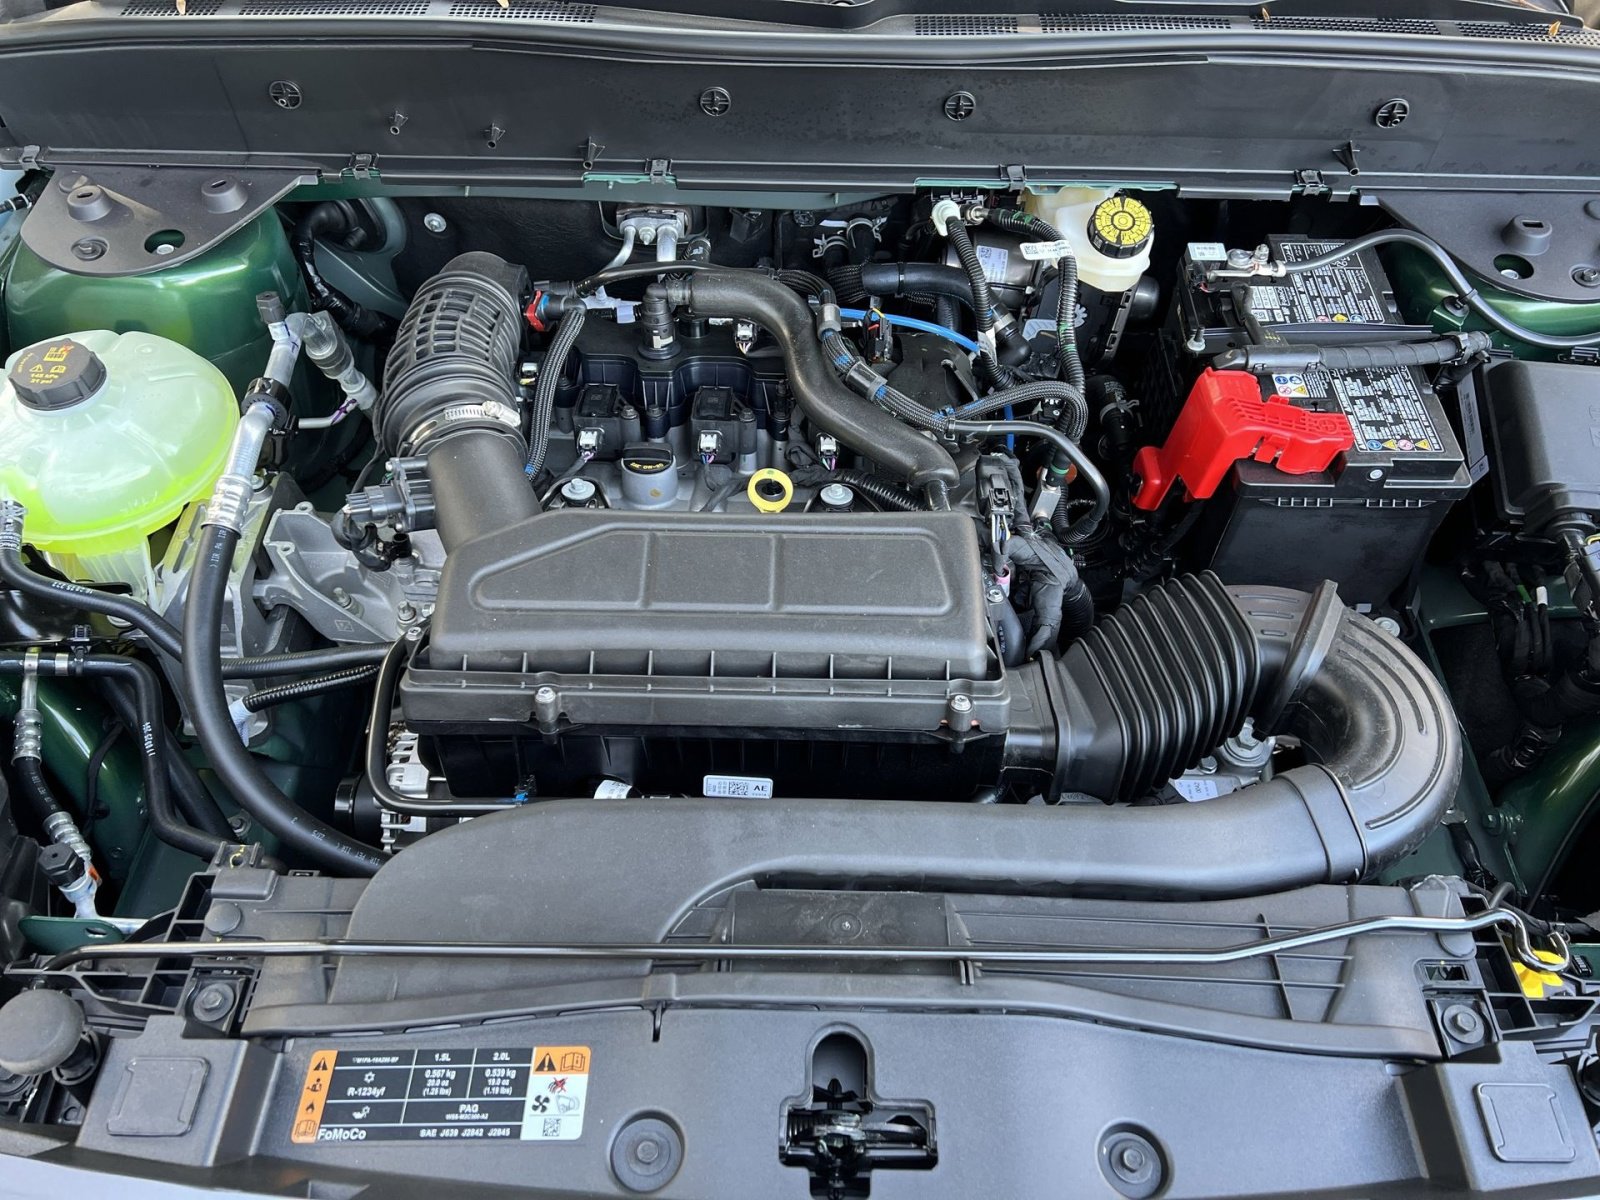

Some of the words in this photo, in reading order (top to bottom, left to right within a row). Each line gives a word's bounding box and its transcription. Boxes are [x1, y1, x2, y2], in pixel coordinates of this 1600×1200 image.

[435, 1053, 451, 1062] 1.5L
[493, 1052, 510, 1060] 2.0L
[424, 1069, 445, 1078] 0.567
[446, 1069, 456, 1080] kg
[485, 1068, 505, 1078] 0.539
[506, 1068, 516, 1079] kg
[347, 1086, 386, 1098] R-1234yf
[459, 1104, 479, 1113] PAG
[317, 1128, 367, 1141] FoMoCo
[420, 1129, 437, 1137] SAE
[440, 1128, 458, 1137] J639
